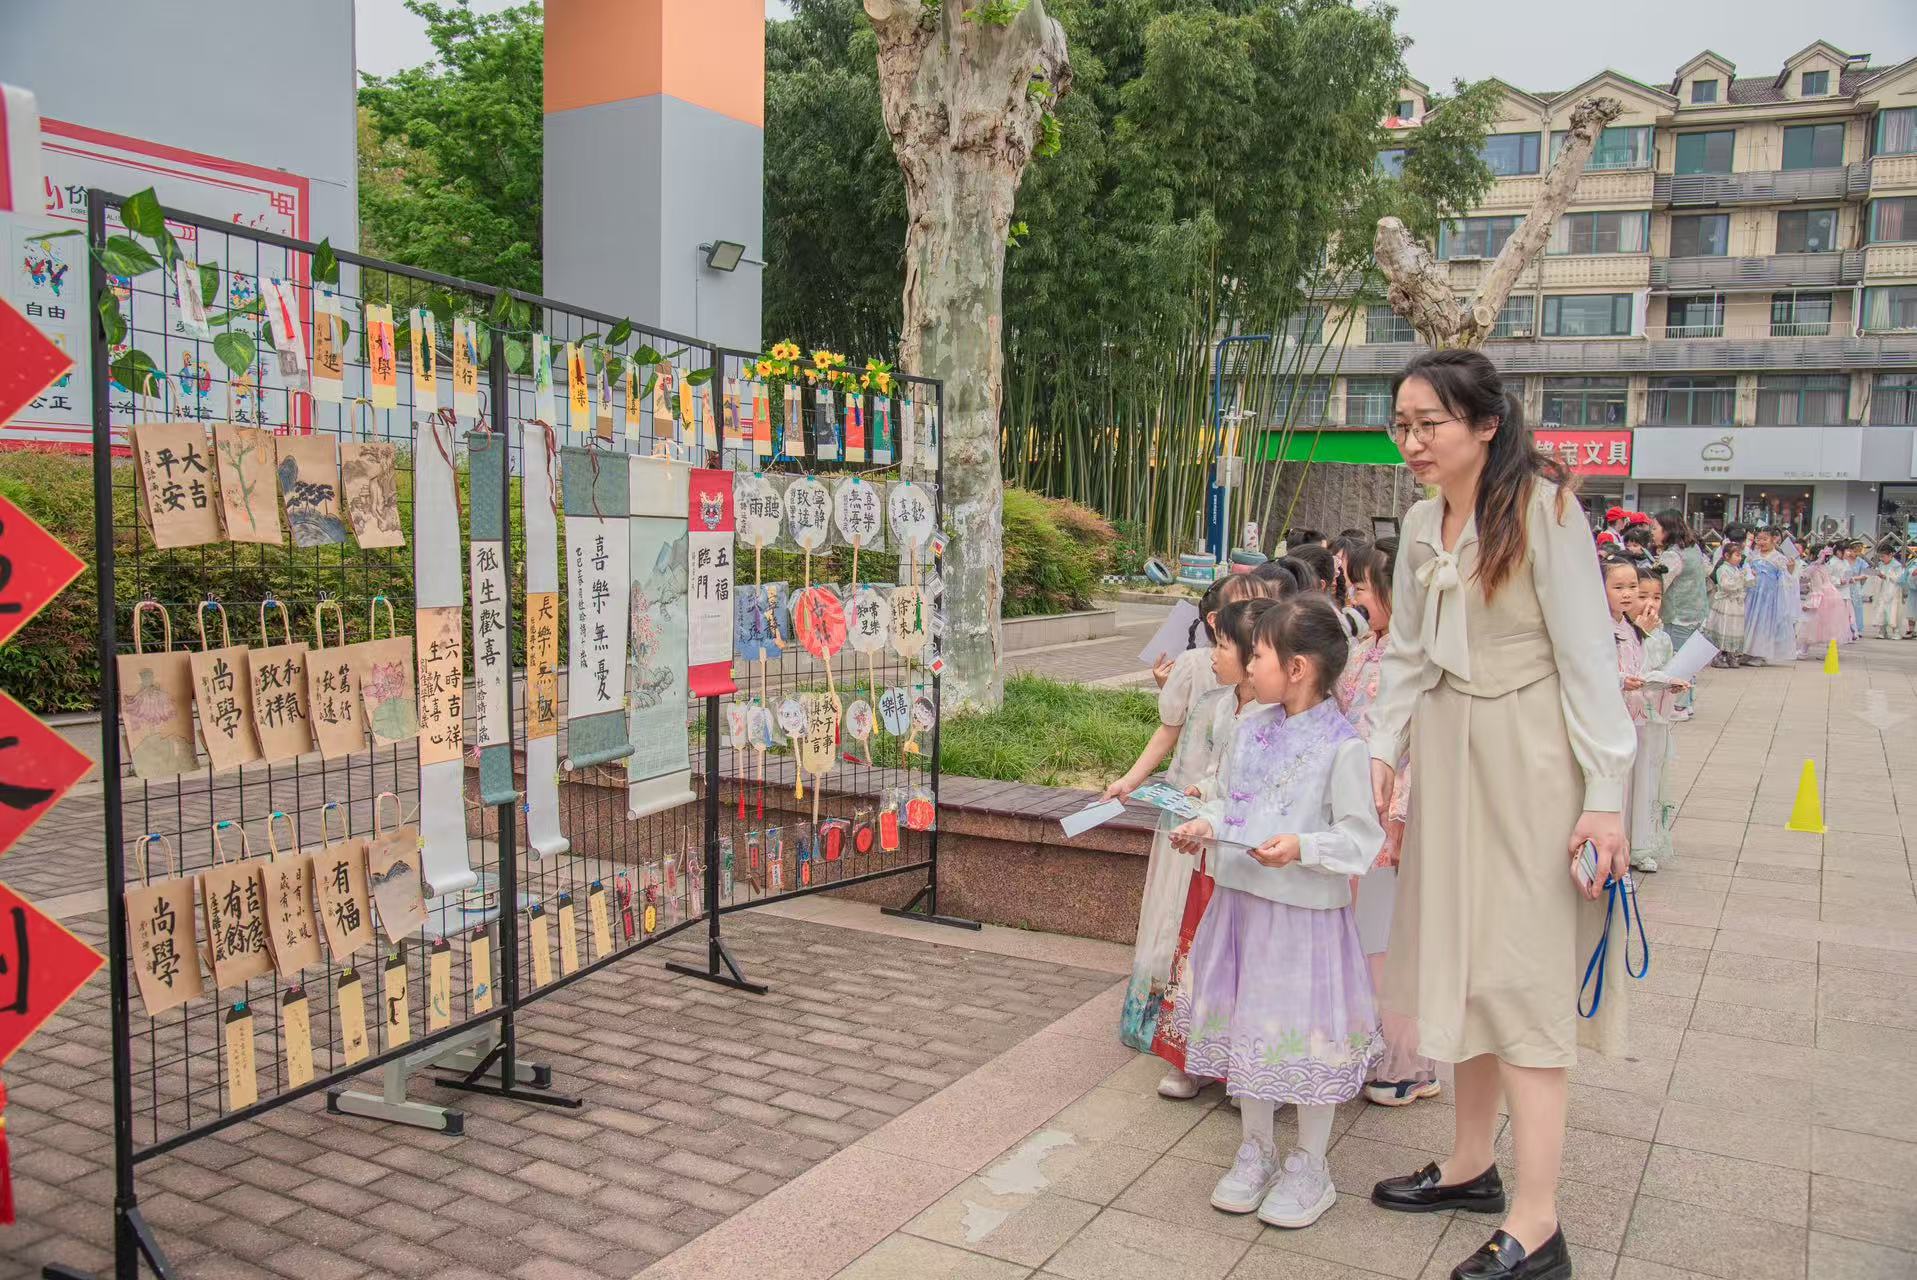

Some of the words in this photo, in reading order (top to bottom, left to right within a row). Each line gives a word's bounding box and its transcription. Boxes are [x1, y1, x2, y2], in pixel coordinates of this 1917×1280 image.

[26, 302, 66, 320] 自由
[156, 448, 185, 511] 平安
[181, 443, 208, 508] 大吉
[714, 547, 729, 601] 五福
[332, 860, 360, 937] 有福
